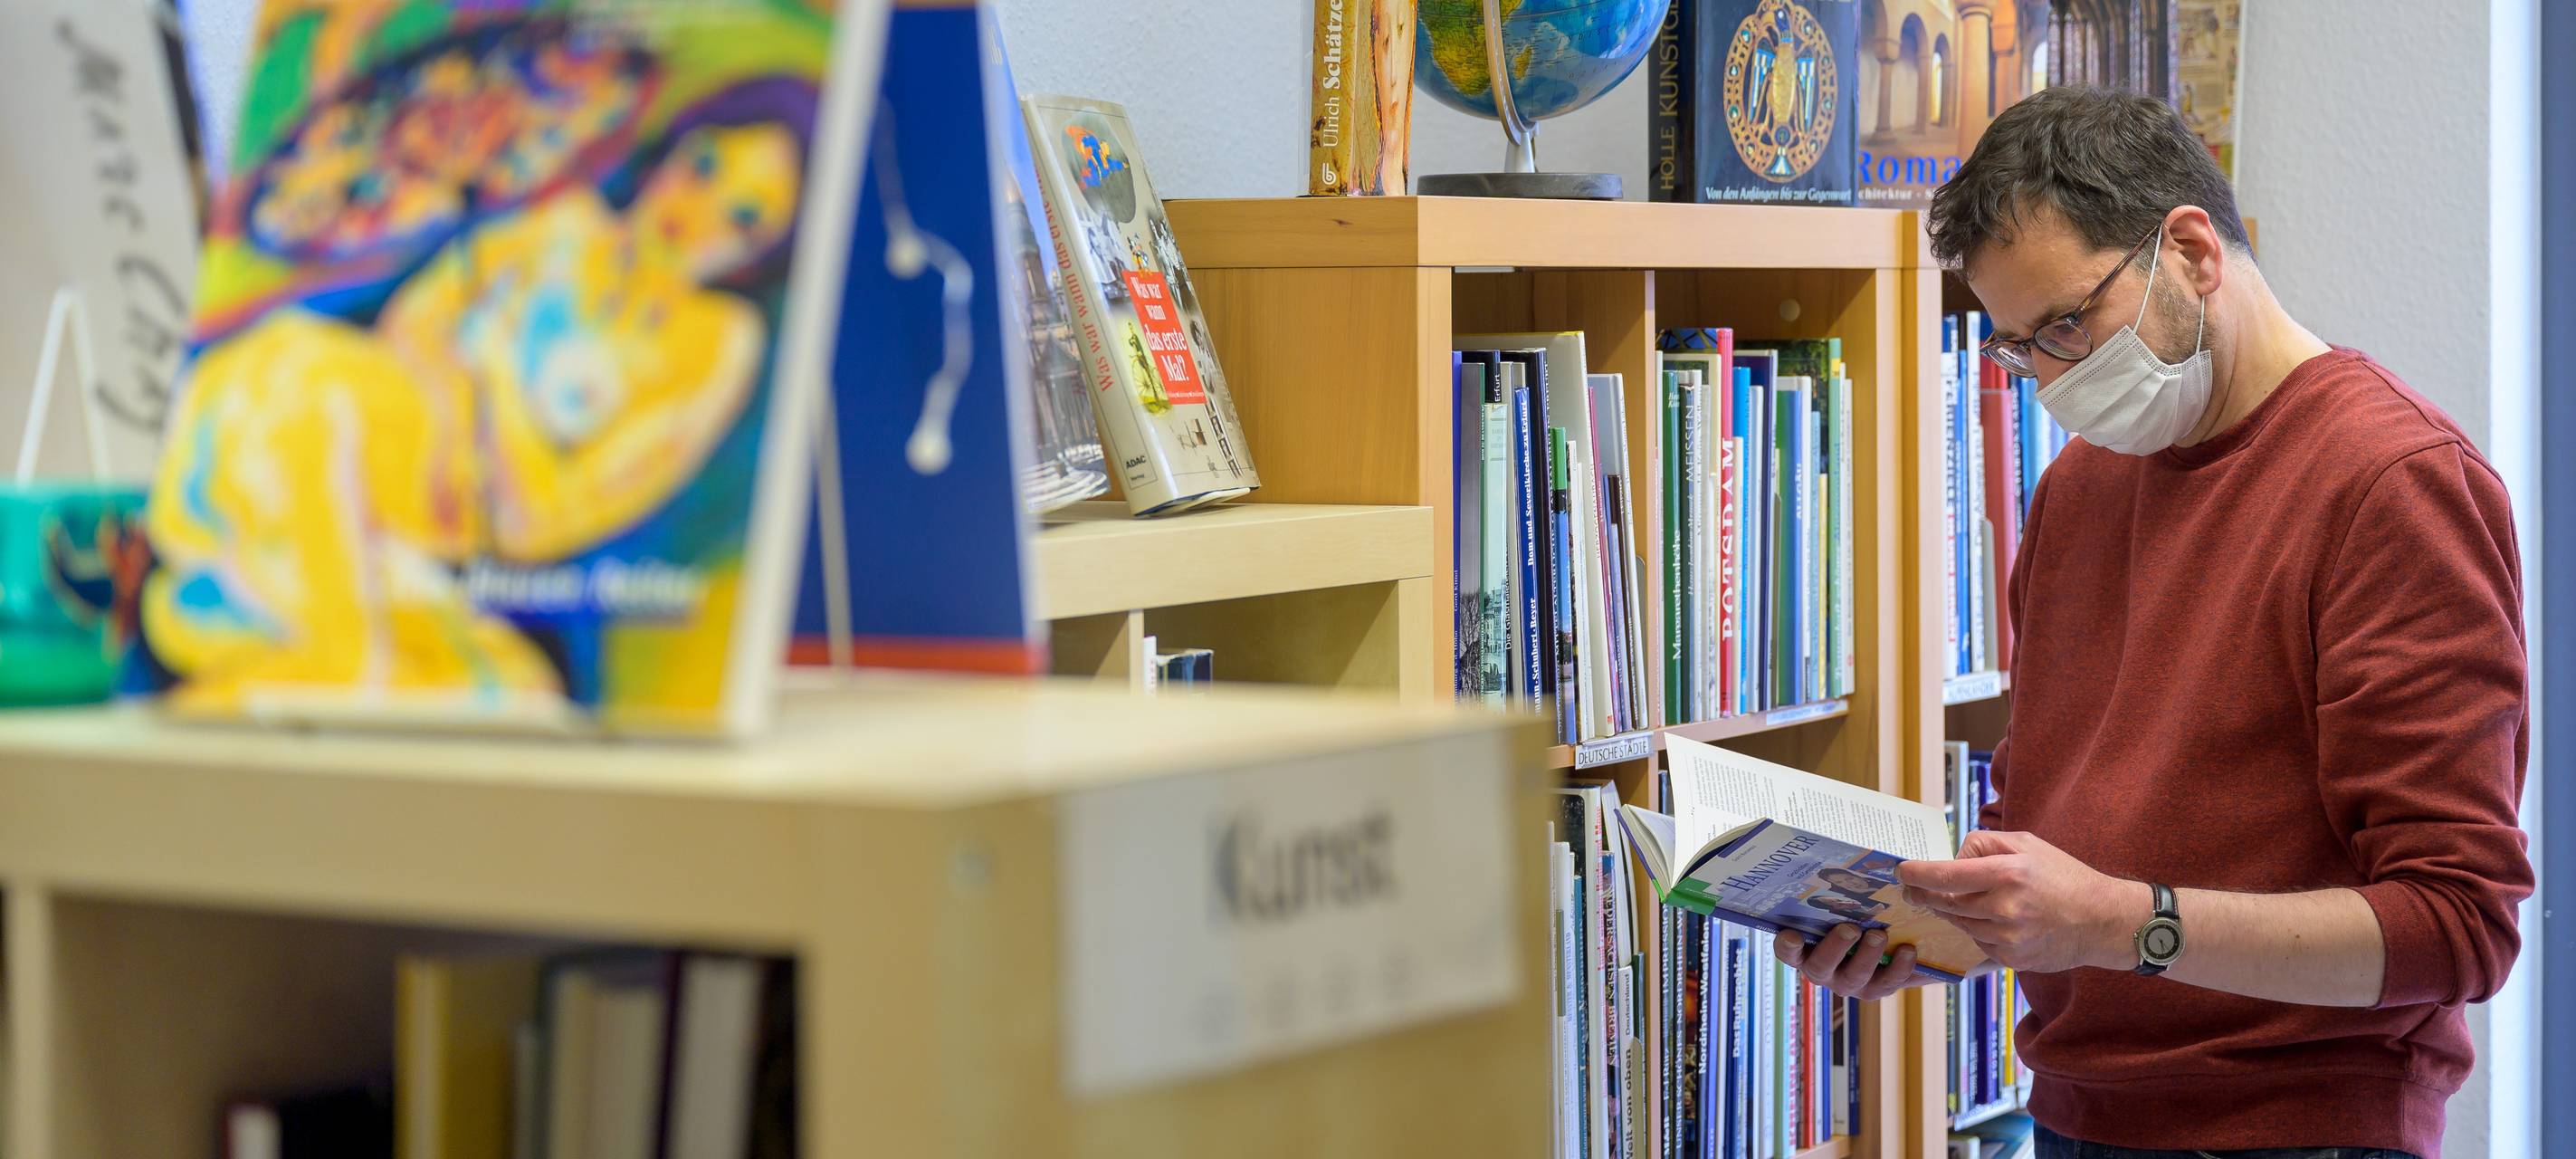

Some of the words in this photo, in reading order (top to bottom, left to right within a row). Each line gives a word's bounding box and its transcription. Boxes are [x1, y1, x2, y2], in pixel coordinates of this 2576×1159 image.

[1322, 96, 1340, 148] Ulrich
[1660, 125, 1674, 190] HOLLE
[1705, 186, 1722, 200] Von
[1722, 186, 1739, 200] den
[1740, 186, 1779, 202] Anfängen
[1779, 186, 1792, 200] bis
[1792, 189, 1807, 200] zur
[1808, 186, 1852, 203] Gegenwart
[1056, 242, 1073, 271] das
[1064, 273, 1092, 316] wann
[1131, 276, 1150, 299] Was
[1148, 283, 1163, 299] war
[1144, 304, 1167, 321] wann
[1081, 321, 1106, 362] war
[1144, 323, 1165, 351] das
[1161, 327, 1188, 351] erste
[1095, 365, 1115, 393] Was
[1160, 354, 1190, 382] Mal?
[1493, 372, 1502, 402] Erfurt
[1125, 455, 1147, 470] ADAC
[1685, 405, 1694, 482] MEISSEN
[1523, 449, 1532, 518] Severikirche
[1722, 437, 1734, 641] POTSDAM
[1673, 529, 1682, 661] Margarethenhöhe
[1531, 631, 1540, 681] Schubert
[1578, 746, 1618, 765] DEUTSCHE
[1618, 740, 1647, 759] STÄDTE
[1209, 806, 1398, 924] Kunst
[1721, 835, 1820, 892] HANNOVER
[1698, 921, 1710, 1075] Nordrhein-Westfalen
[1608, 1005, 1617, 1068] BREMEN
[1624, 1049, 1632, 1091] oben
[1674, 1030, 1684, 1097] SCHÖNES
